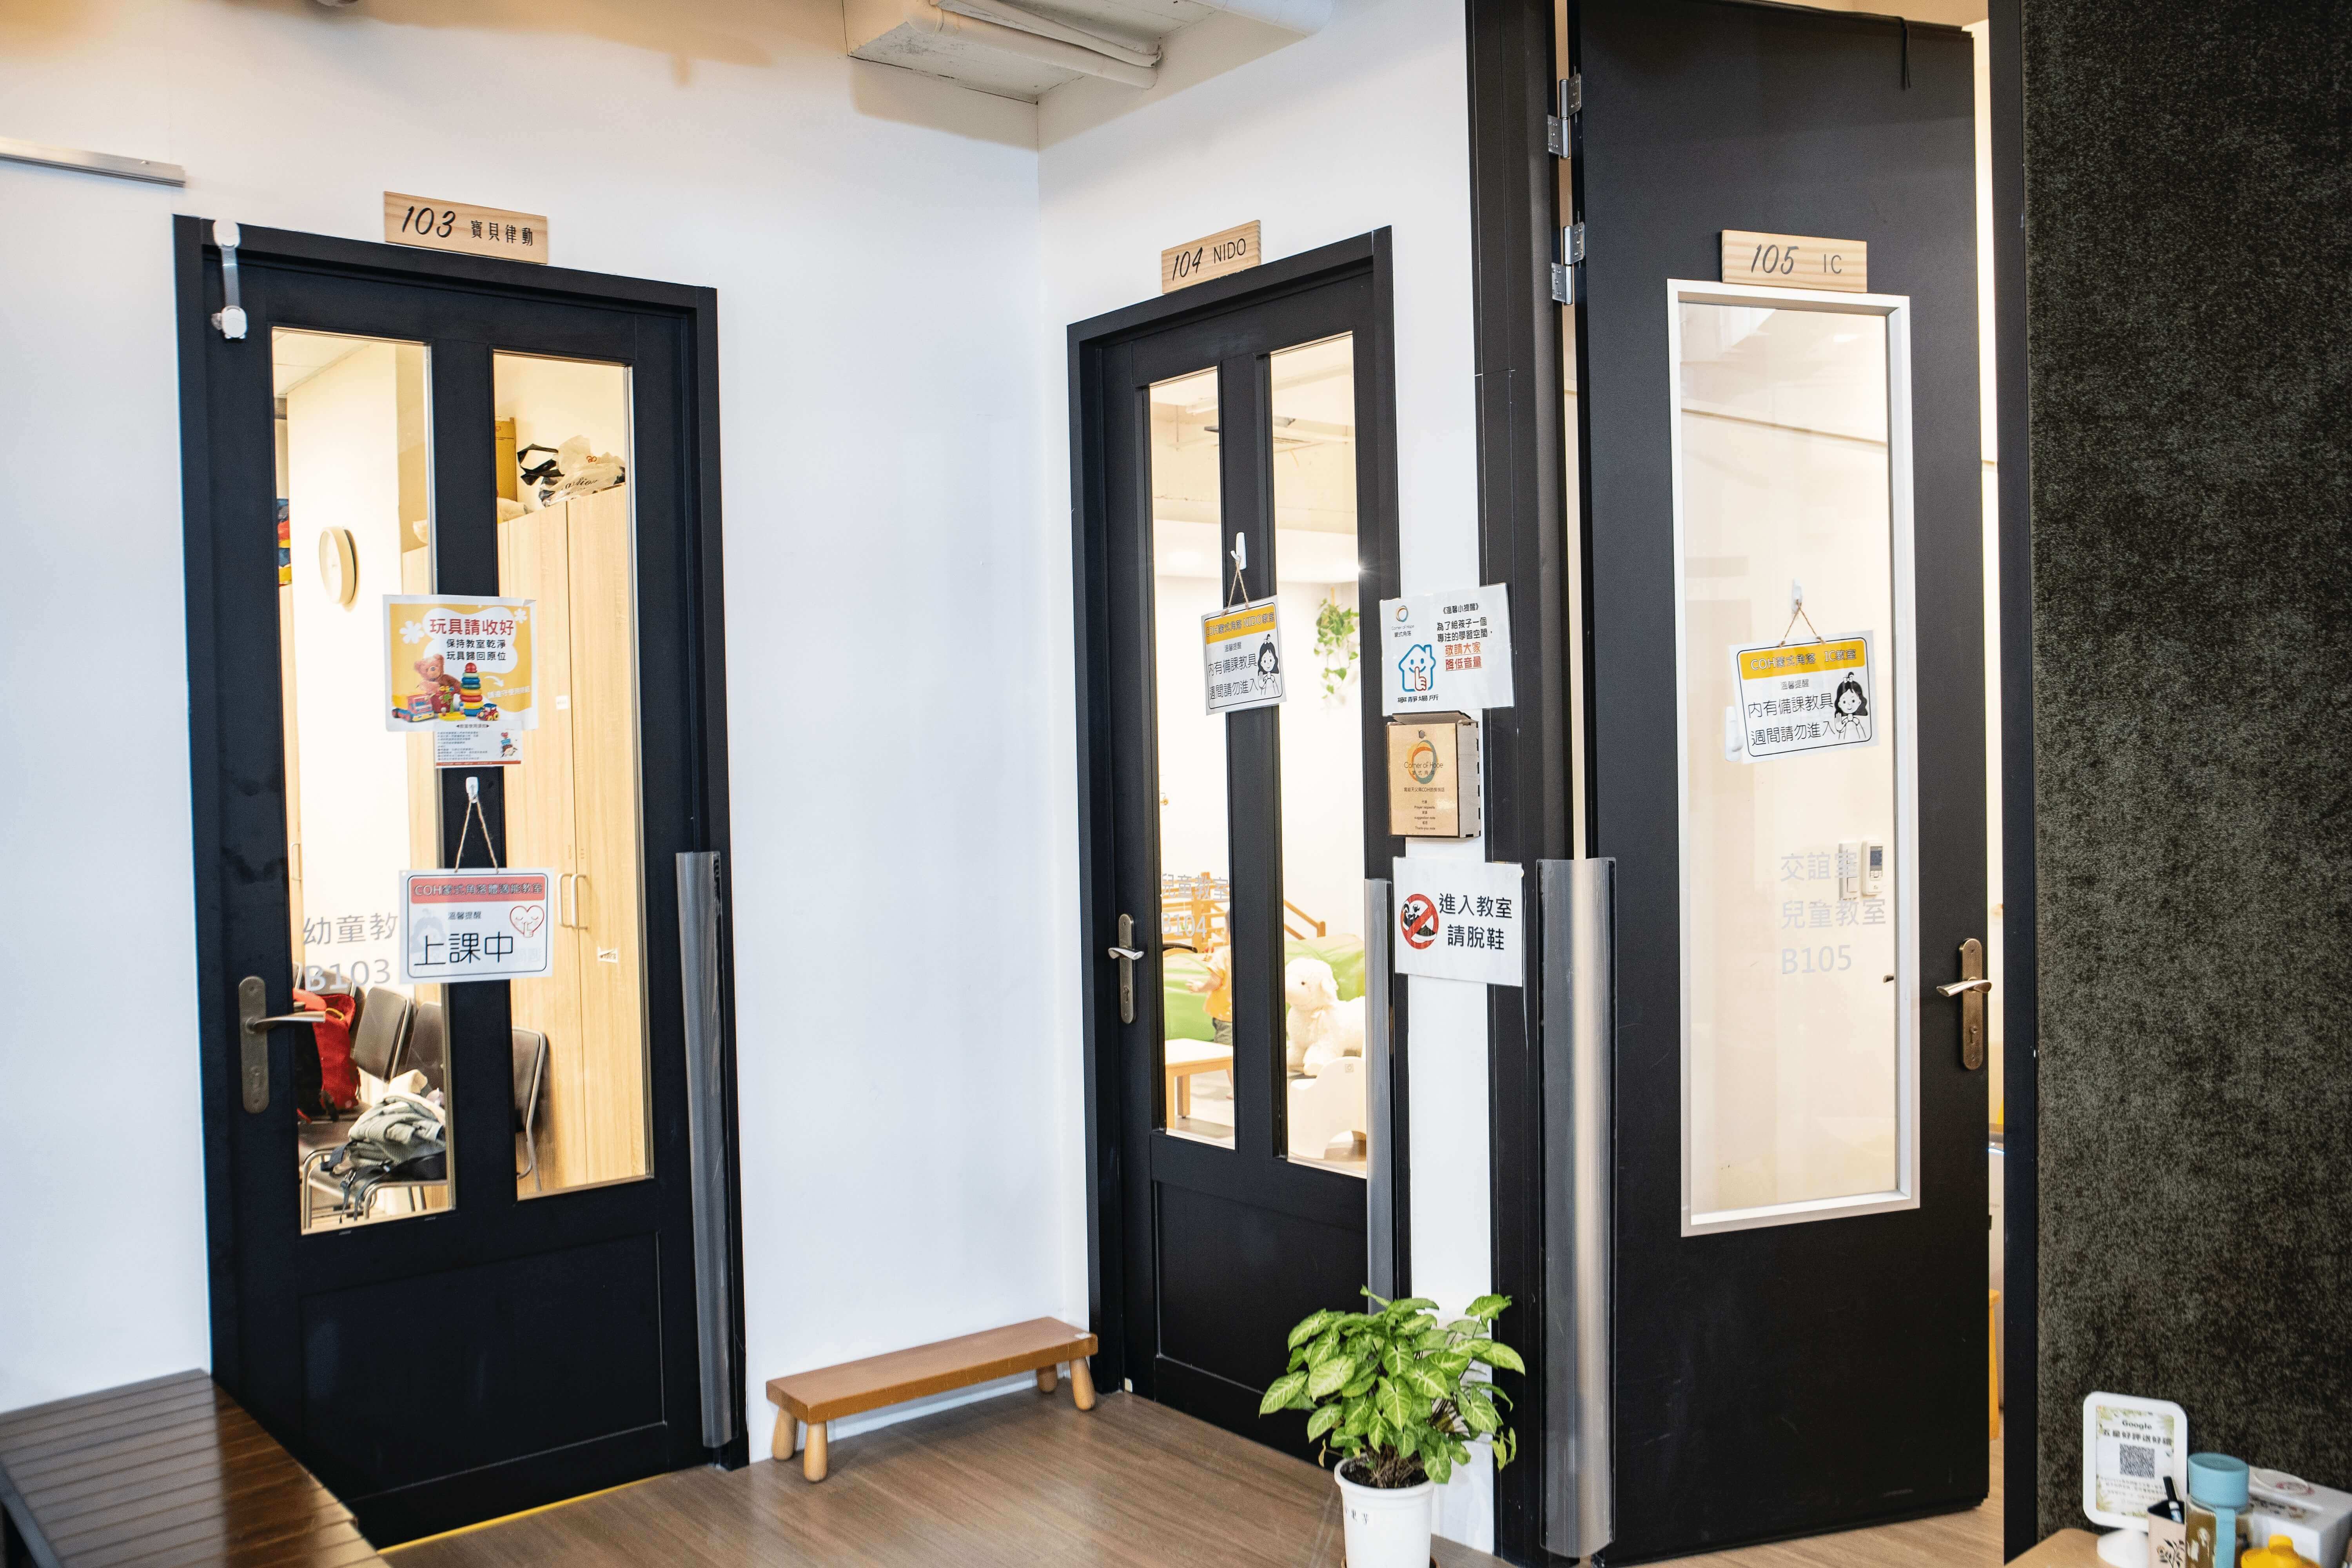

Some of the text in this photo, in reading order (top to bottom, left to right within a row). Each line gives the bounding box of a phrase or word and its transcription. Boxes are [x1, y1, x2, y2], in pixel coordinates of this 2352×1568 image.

[402, 206, 533, 247] 103 寶貝律動
[1172, 238, 1246, 281] 104 NIDO
[1751, 244, 1842, 275] 105 IC
[429, 618, 514, 636] 玩具請收好
[1437, 617, 1487, 632] 為了給孩子一個
[446, 639, 506, 649] 保持教室乾淨
[446, 651, 506, 661] 玩具歸回原位
[1445, 642, 1481, 656] 敬請大家
[1445, 656, 1482, 671] 降低音量
[1751, 649, 1857, 670] COH蒙式角落 IC教室
[1210, 678, 1259, 700] 週間請勿進入
[1751, 721, 1836, 746] 週間請勿進入
[1780, 851, 1858, 882] 交誼室
[1160, 873, 1230, 902] 兒童教室
[1439, 893, 1512, 919] 進入教室
[1781, 897, 1886, 929] 兒童教室
[1161, 912, 1207, 939] B104
[1447, 924, 1504, 950] 請脫鞋
[414, 931, 514, 966] 上課中
[1782, 944, 1852, 975] B105
[305, 959, 391, 991] B103
[2122, 1419, 2152, 1430] Google
